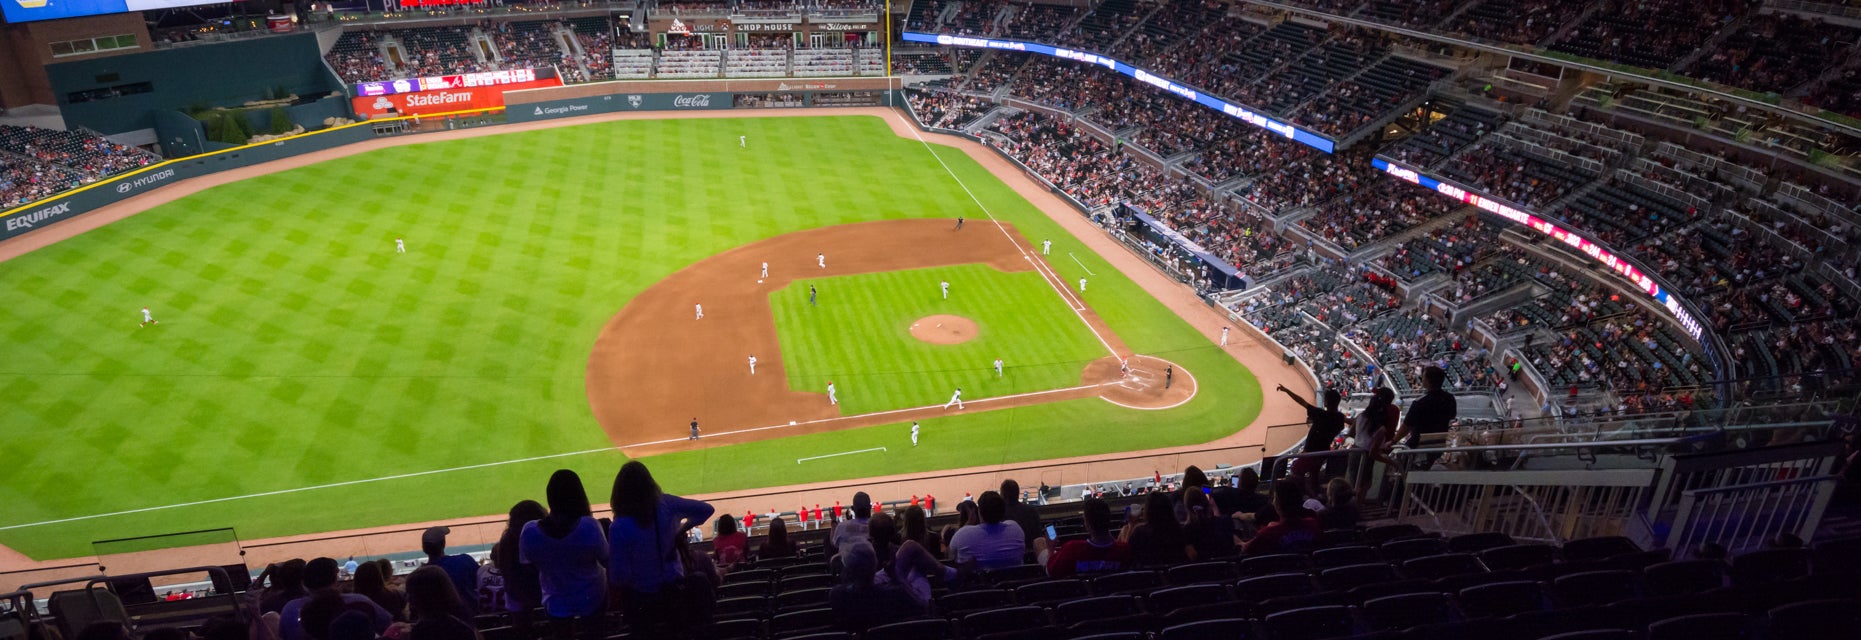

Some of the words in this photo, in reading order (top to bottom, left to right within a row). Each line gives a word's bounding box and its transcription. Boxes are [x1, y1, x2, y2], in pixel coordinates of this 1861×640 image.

[693, 24, 714, 32] LIGHT
[737, 23, 761, 31] CHOP
[764, 23, 793, 31] HOUSE
[134, 169, 174, 188] HYUNDAI
[6, 201, 70, 231] EQUIFAX
